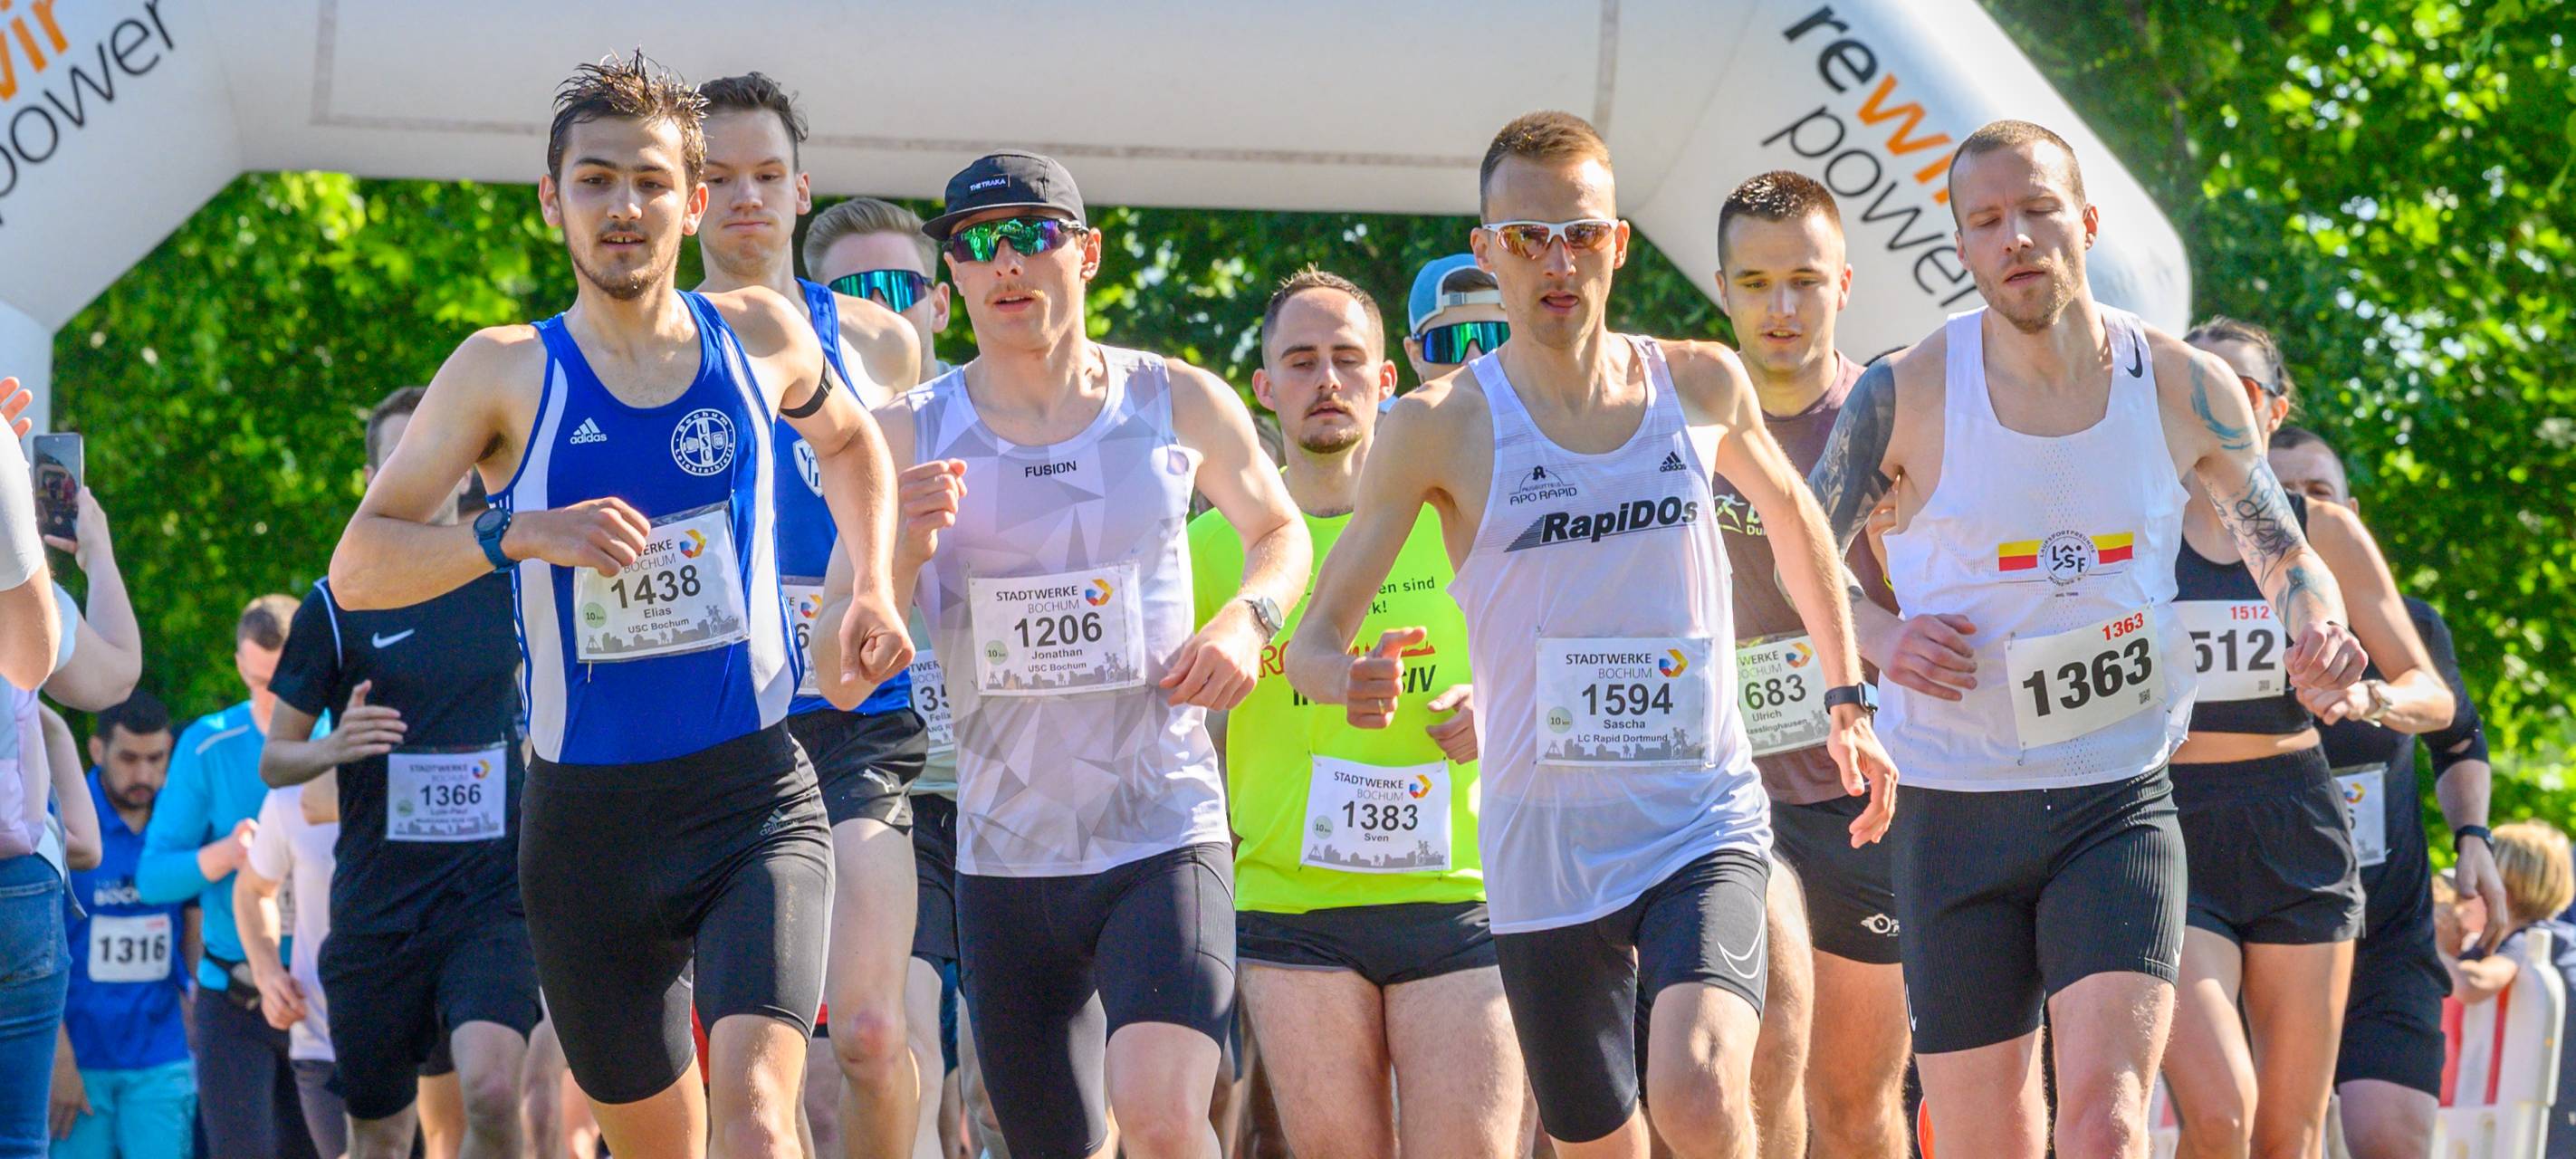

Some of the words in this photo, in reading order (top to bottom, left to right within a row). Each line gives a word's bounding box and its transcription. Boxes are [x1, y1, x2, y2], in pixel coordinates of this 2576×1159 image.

[982, 178, 1006, 187] TRAKA
[570, 433, 608, 445] adidas
[1024, 460, 1077, 478] FUSION
[1659, 463, 1687, 473] adidas
[1509, 492, 1537, 505] APO
[1539, 487, 1577, 500] RAPID
[1541, 496, 1699, 543] RapiDOs
[623, 552, 677, 574] BOCHUM
[610, 564, 701, 609] 1438
[1403, 576, 1435, 592] sind
[996, 585, 1078, 602] STADTWERKE
[644, 607, 672, 619] Elias
[1028, 599, 1080, 614] BOCHUM
[2230, 605, 2270, 620] 1512
[586, 611, 596, 621] 10
[627, 624, 648, 635] USC
[651, 617, 690, 631] Bochum
[1014, 612, 1103, 647] 1206
[2102, 612, 2144, 641] 1363
[987, 648, 998, 658] 10
[1031, 648, 1083, 660] Jonathan
[1566, 653, 1652, 665] STADTWERKE
[1028, 664, 1048, 674] USC
[1050, 661, 1087, 672] Bochum
[1599, 667, 1652, 679] BOCHUM
[2023, 637, 2152, 717] 1363
[1582, 683, 1673, 715] 1594
[929, 713, 952, 723] Felix
[1550, 716, 1561, 725] 10
[1752, 710, 1782, 722] Ulrich
[1604, 719, 1646, 729] Sascha
[1577, 734, 1591, 742] LC
[1594, 733, 1621, 745] Rapid
[1623, 733, 1669, 743] Dortmund
[1334, 771, 1403, 789] STADTWERKE
[420, 783, 482, 806] 1366
[1357, 789, 1403, 801] BOCHUM
[1342, 800, 1418, 831] 1383
[1316, 823, 1324, 832] 10
[1364, 832, 1389, 842] Sven
[100, 935, 167, 963] 1316
